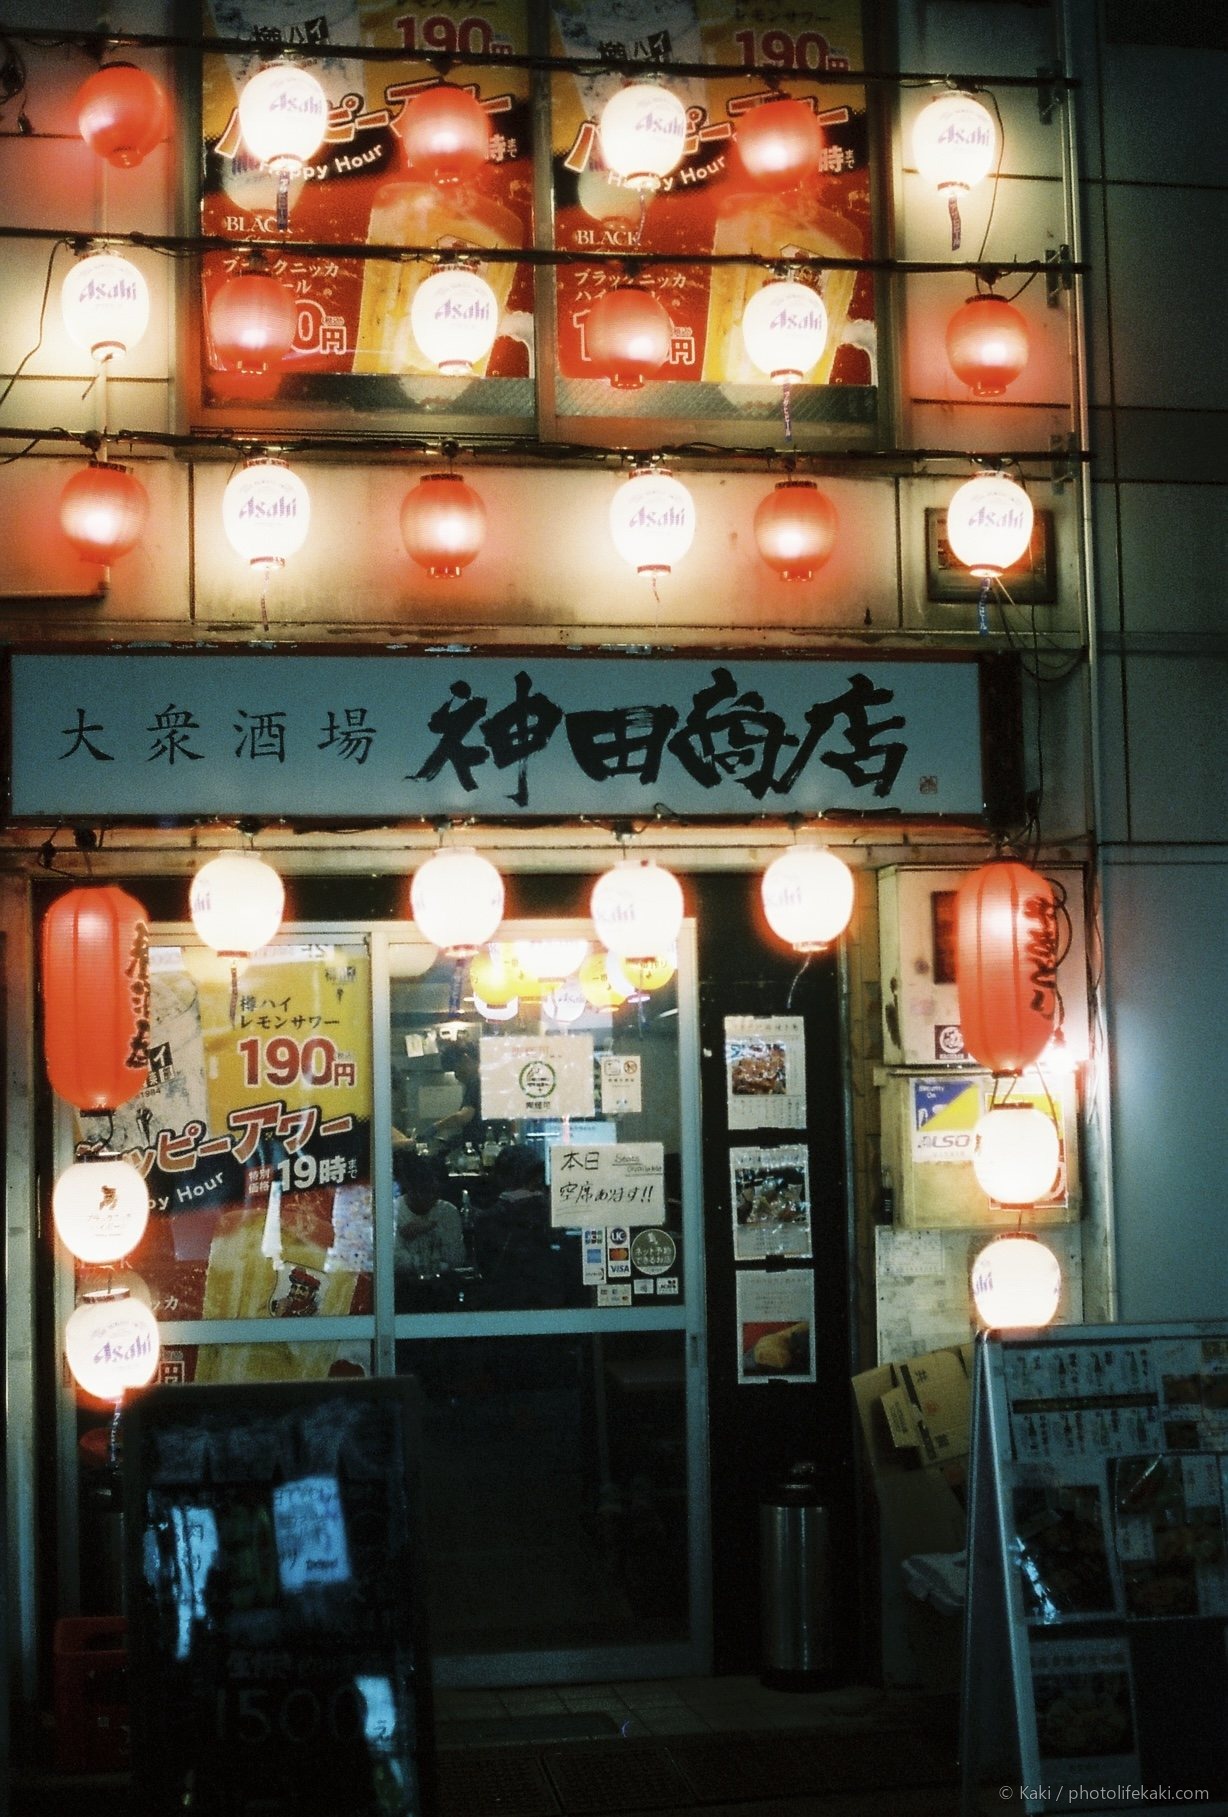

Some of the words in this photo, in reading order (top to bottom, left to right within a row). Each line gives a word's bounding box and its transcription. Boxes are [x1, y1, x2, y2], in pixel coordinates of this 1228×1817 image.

[938, 124, 990, 147] Asahi
[334, 144, 384, 173] Hour
[680, 155, 727, 185] Hour
[577, 230, 641, 246] BLACK
[79, 279, 137, 303] Asahi
[435, 298, 490, 320] Asahi
[769, 308, 822, 331] Asahi
[238, 495, 296, 519] Asahi
[628, 505, 685, 528] Asahi
[968, 505, 1025, 529] Asahi
[58, 702, 378, 766] 大衆酒場
[403, 668, 908, 806] 神田商店
[240, 1016, 340, 1030] レモンサワー
[561, 1152, 600, 1171] 本日
[177, 1171, 224, 1203] Hour
[610, 1265, 630, 1273] VISA
[93, 1332, 152, 1365] Asahi
